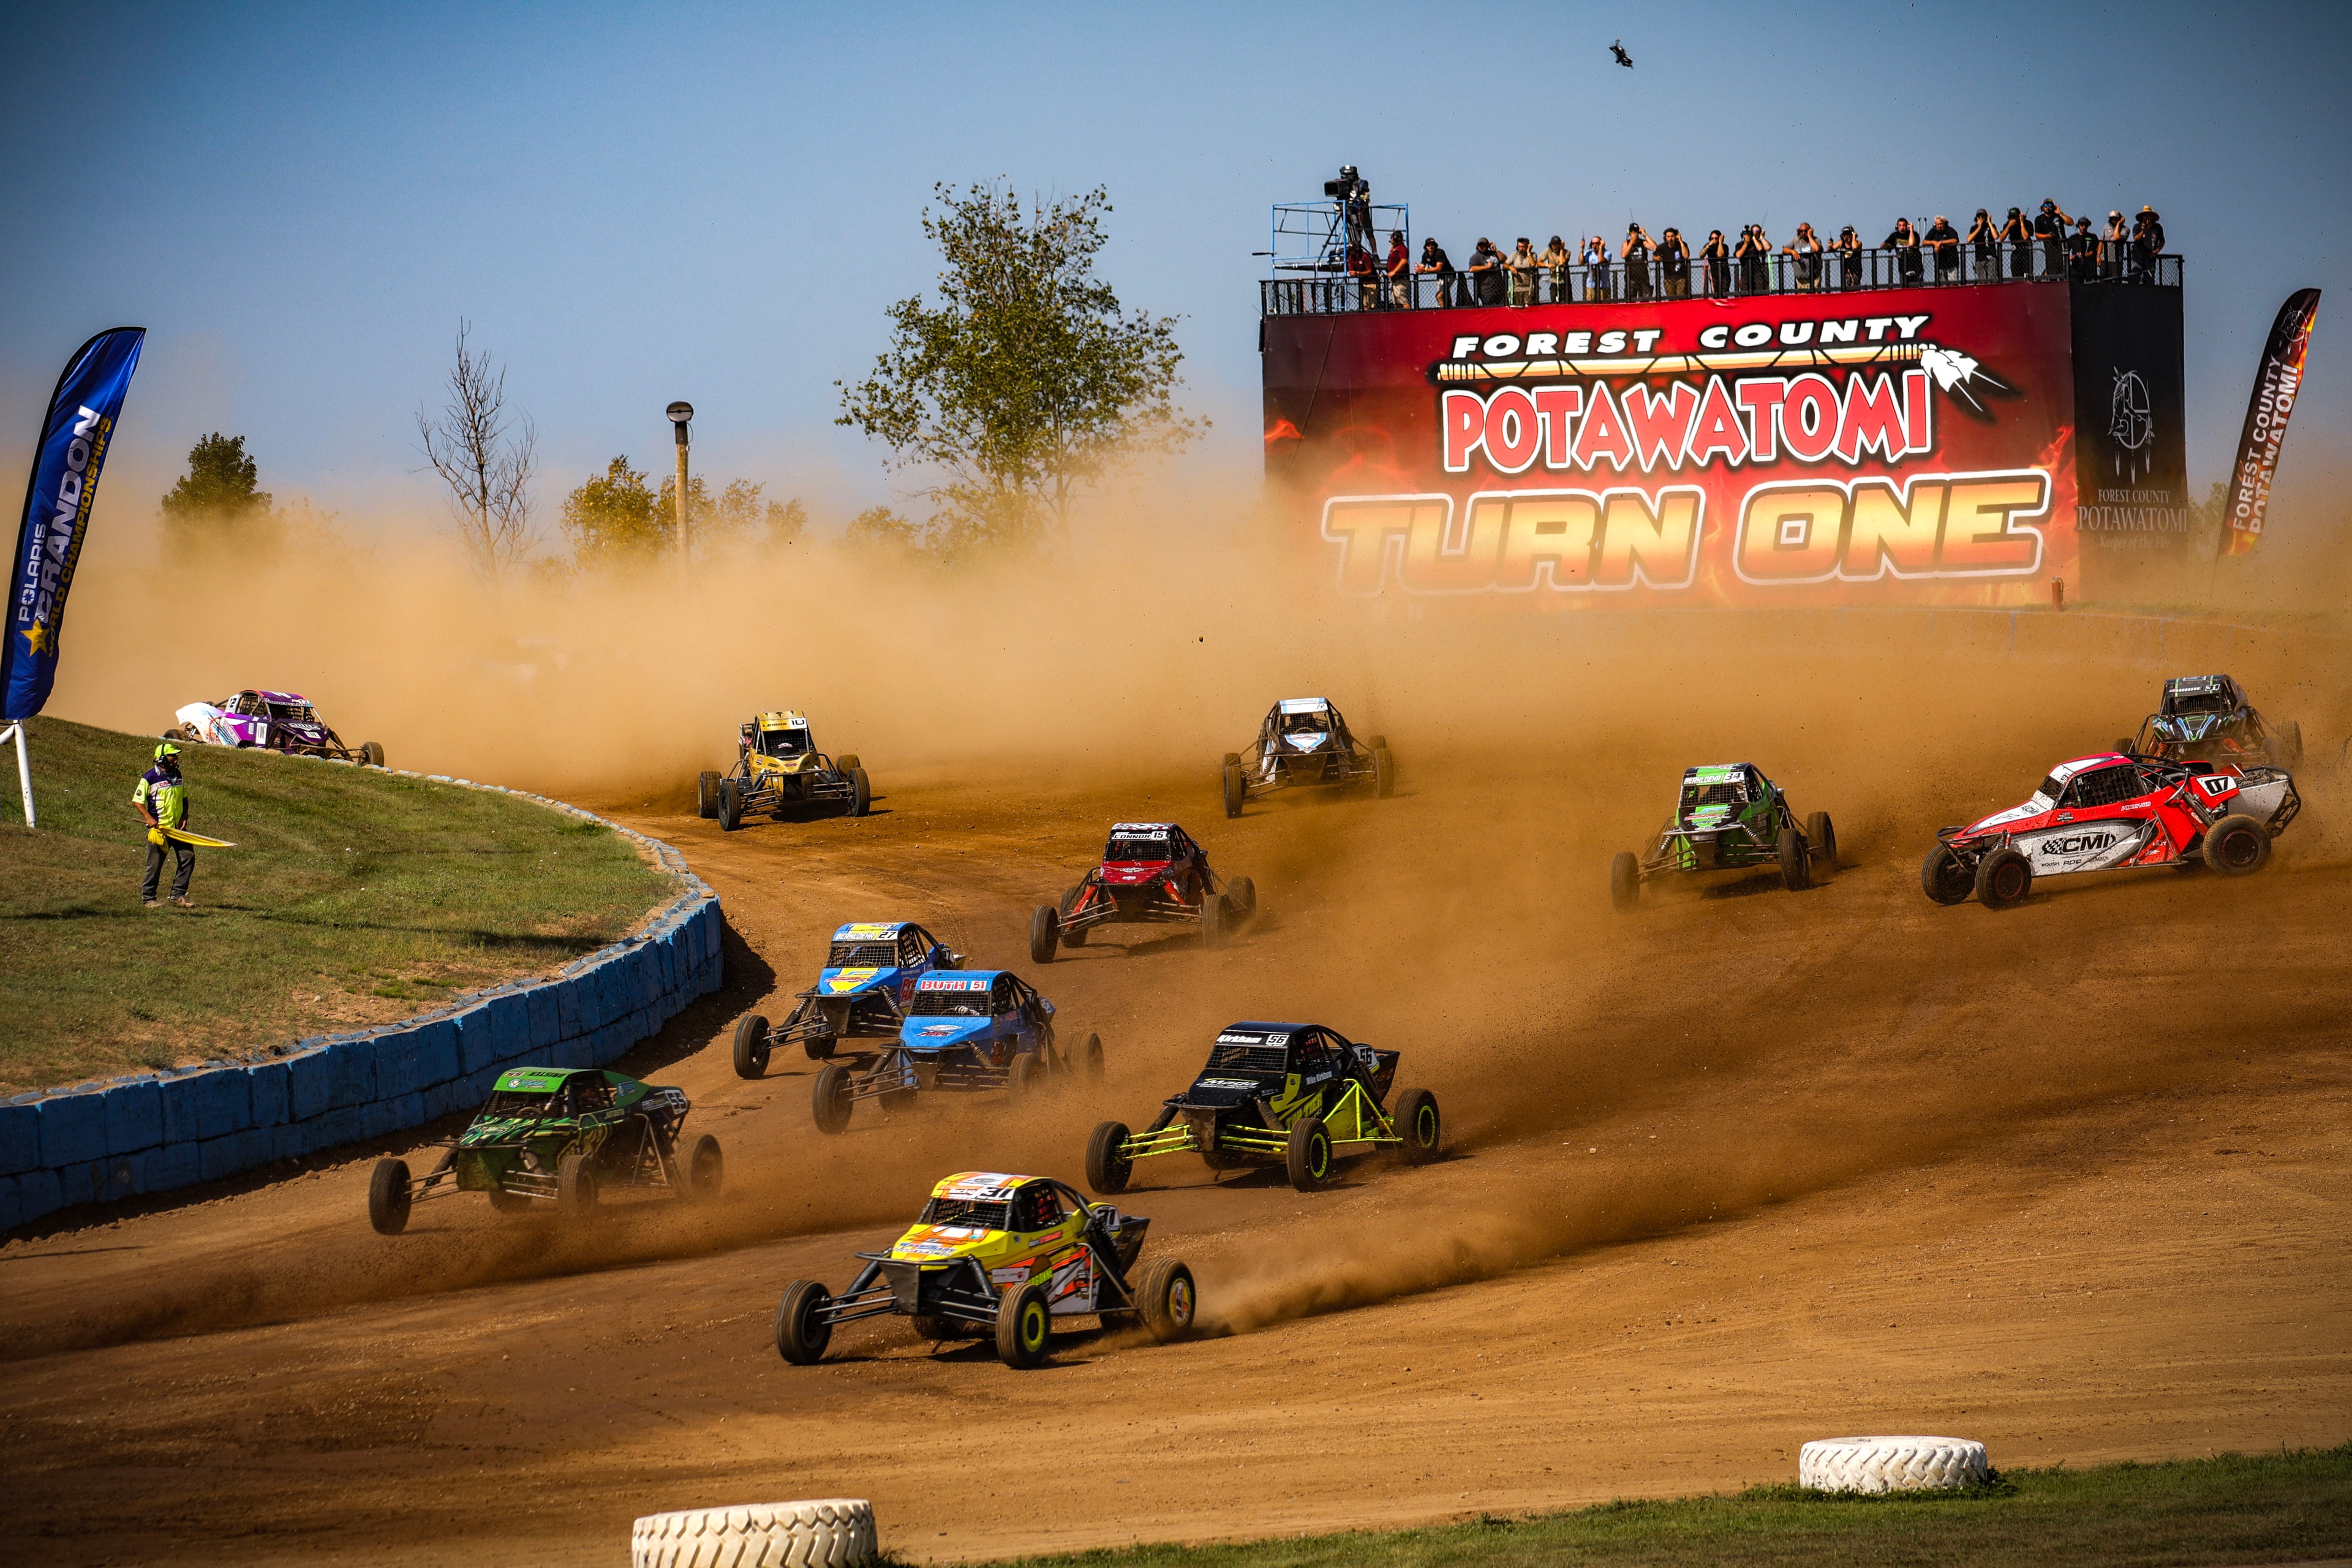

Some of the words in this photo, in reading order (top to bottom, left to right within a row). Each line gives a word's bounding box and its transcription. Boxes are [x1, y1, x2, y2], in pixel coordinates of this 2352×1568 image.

[1452, 328, 1661, 360] FOREST
[1700, 315, 1930, 349] COUNTY
[1442, 369, 1932, 473] POTAWATOMI
[2233, 447, 2262, 530] FOREST
[2253, 354, 2281, 442] COUNTY
[2249, 363, 2299, 534] POTAWATOMI
[2098, 489, 2130, 503] FOREST
[2132, 490, 2171, 503] COUNTY
[34, 404, 101, 624] CRANDON
[2077, 506, 2188, 532] POTAWATOMI
[48, 586, 66, 658] WORLD
[61, 416, 112, 583] CHAMPIONSHIPS
[1321, 485, 1706, 597] TURN
[1732, 469, 2052, 586] ONE
[2100, 535, 2126, 549] Keeper
[2128, 535, 2137, 549] of
[2139, 535, 2152, 549] the
[18, 524, 47, 622] POLARIS
[1725, 772, 1741, 781] 34
[2204, 777, 2228, 794] 07
[2062, 833, 2111, 853] CMI
[921, 980, 967, 990] BUTH
[1360, 1048, 1373, 1065] 56
[979, 1187, 1013, 1198] 31
